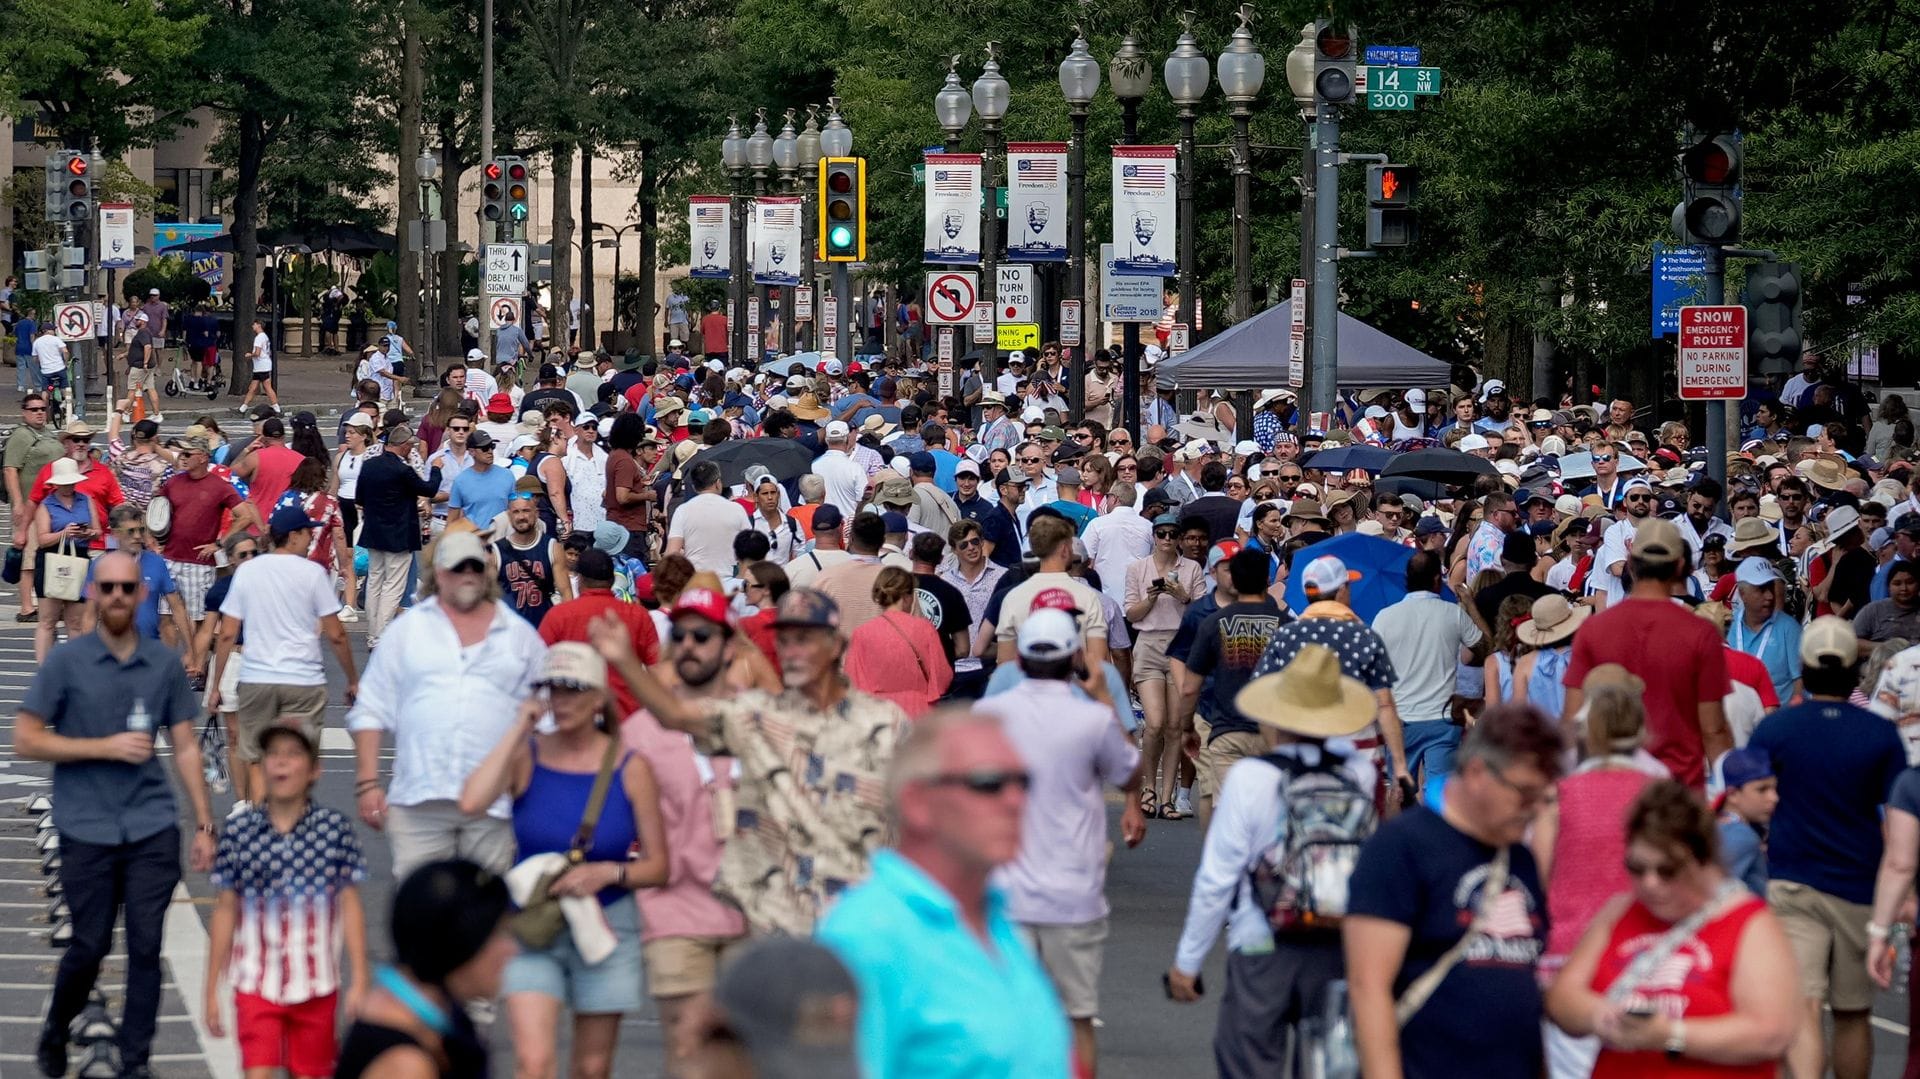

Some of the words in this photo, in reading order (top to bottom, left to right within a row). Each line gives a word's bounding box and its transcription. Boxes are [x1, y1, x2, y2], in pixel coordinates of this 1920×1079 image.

[1401, 51, 1418, 61] ROUTE
[1378, 70, 1400, 90] 14
[1417, 70, 1431, 81] St
[1417, 81, 1432, 91] NW
[1373, 94, 1408, 107] 300
[1151, 190, 1165, 198] 250
[488, 247, 507, 256] THRU
[487, 274, 506, 282] OBEY
[509, 274, 525, 283] THIS
[1001, 270, 1020, 280] NO
[487, 284, 511, 292] SIGNAL
[999, 283, 1023, 293] TURN
[1010, 295, 1029, 304] RED
[1694, 312, 1732, 322] SNOW
[1685, 326, 1740, 334] EMERGENCY
[1693, 336, 1733, 345] ROUTE
[1687, 352, 1698, 360] NO
[1702, 352, 1740, 361] PARKING
[1695, 364, 1731, 373] DURING
[1685, 376, 1741, 385] EMERGENCY
[506, 559, 546, 581] USA
[511, 580, 543, 609] 76
[1219, 614, 1280, 638] VANS
